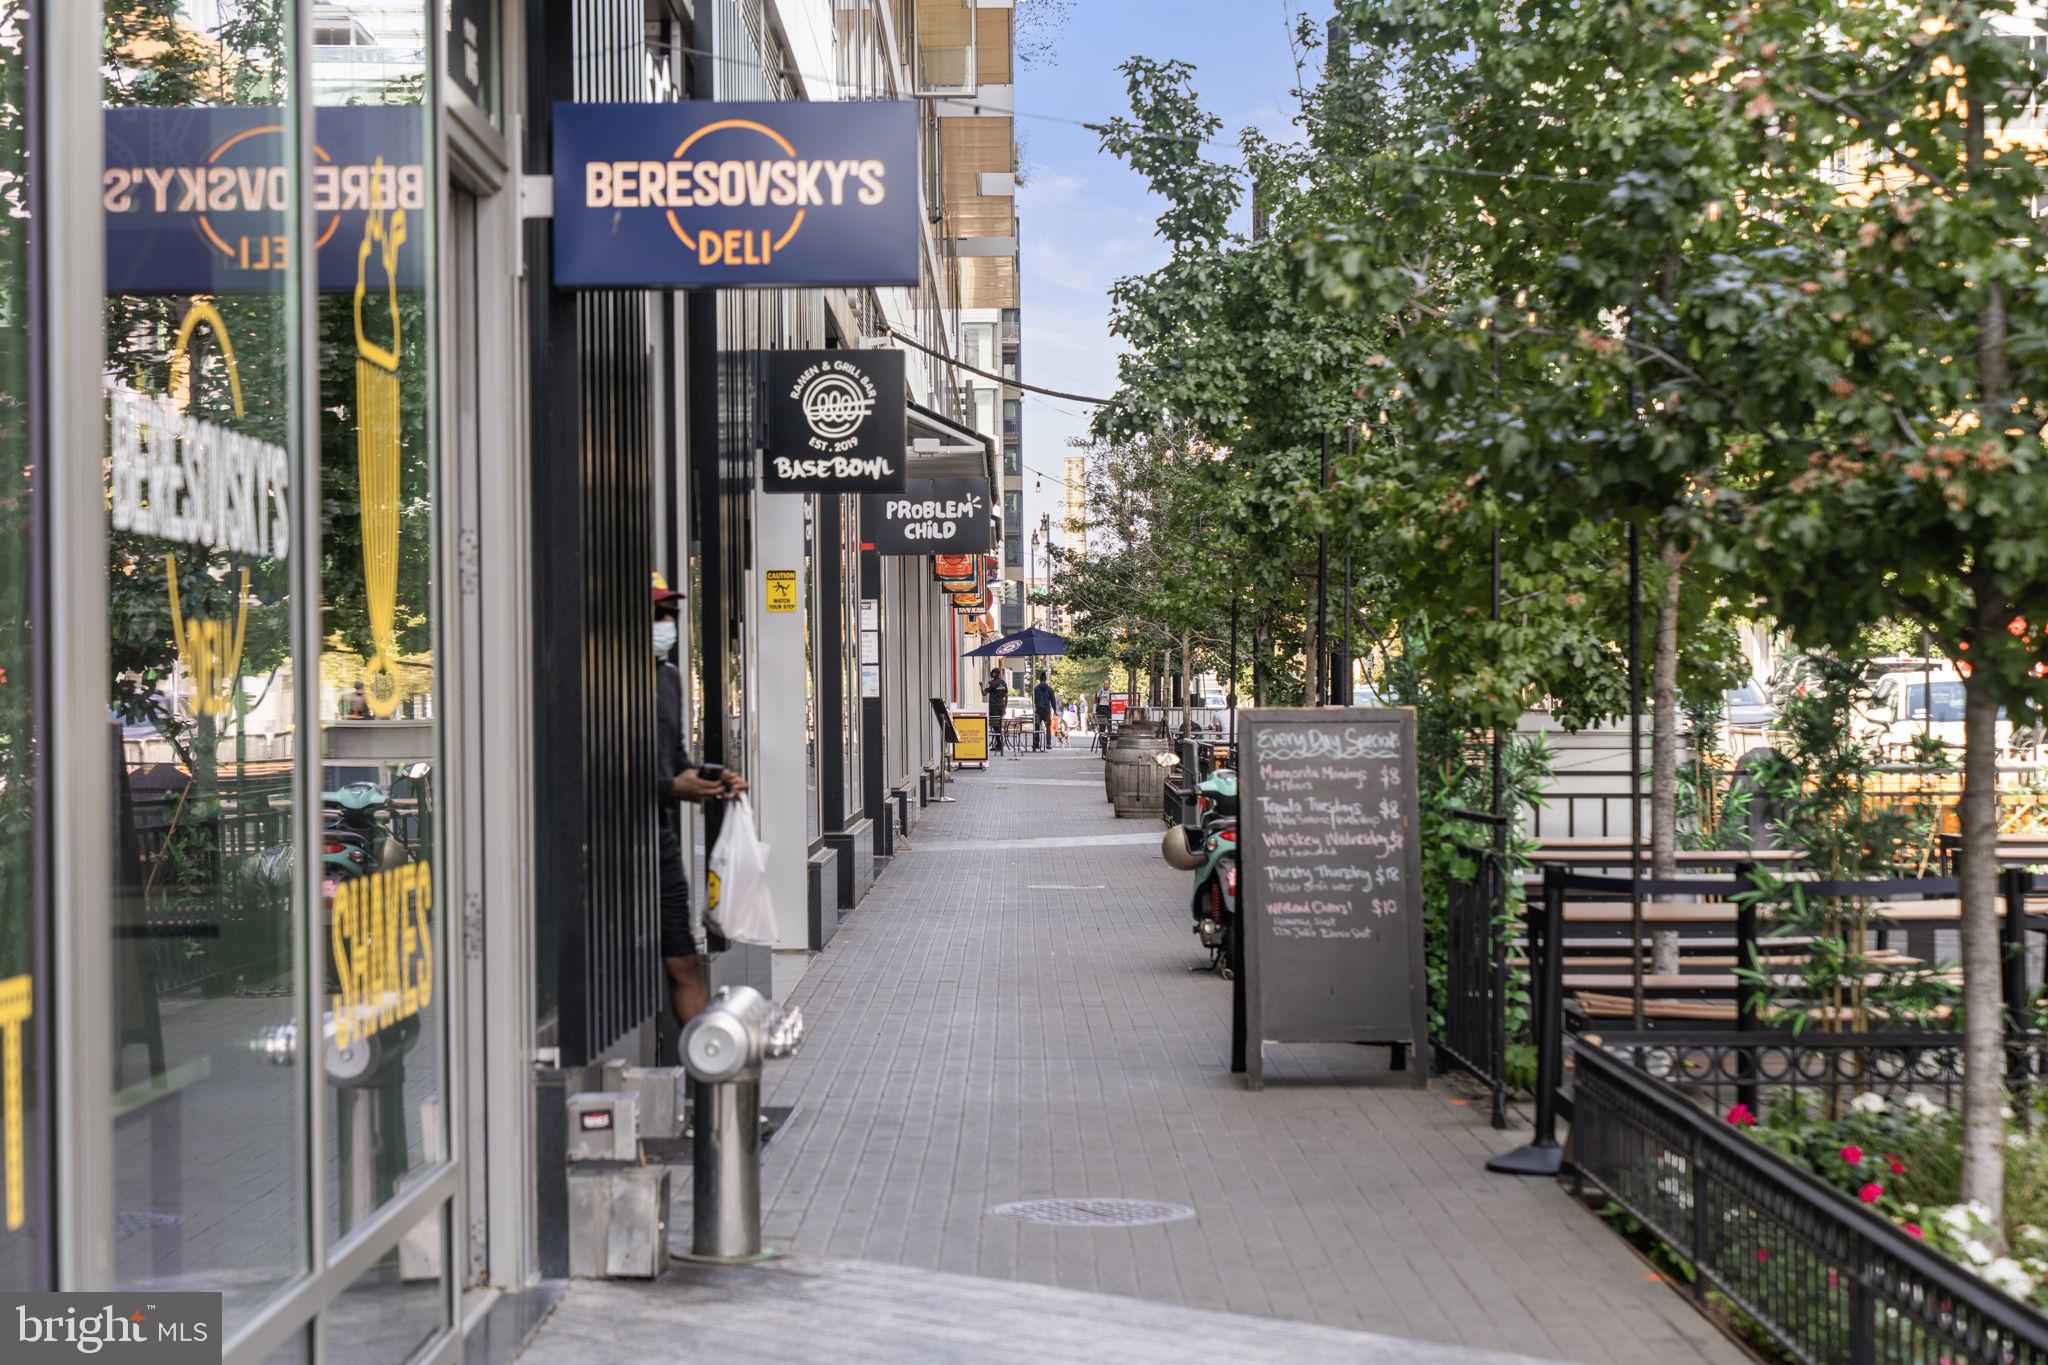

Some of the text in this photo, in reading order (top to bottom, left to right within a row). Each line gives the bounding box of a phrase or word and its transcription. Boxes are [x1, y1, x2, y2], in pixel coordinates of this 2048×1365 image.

[585, 160, 886, 208] BERESOVSKY'S
[698, 229, 771, 266] DELI
[789, 360, 877, 400] RAMEN & GRILL BAR
[834, 436, 859, 452] 2019
[1308, 729, 1342, 755] Day
[1380, 764, 1402, 790] $8
[1262, 832, 1323, 850] Whiskey
[1371, 897, 1397, 918] $10
